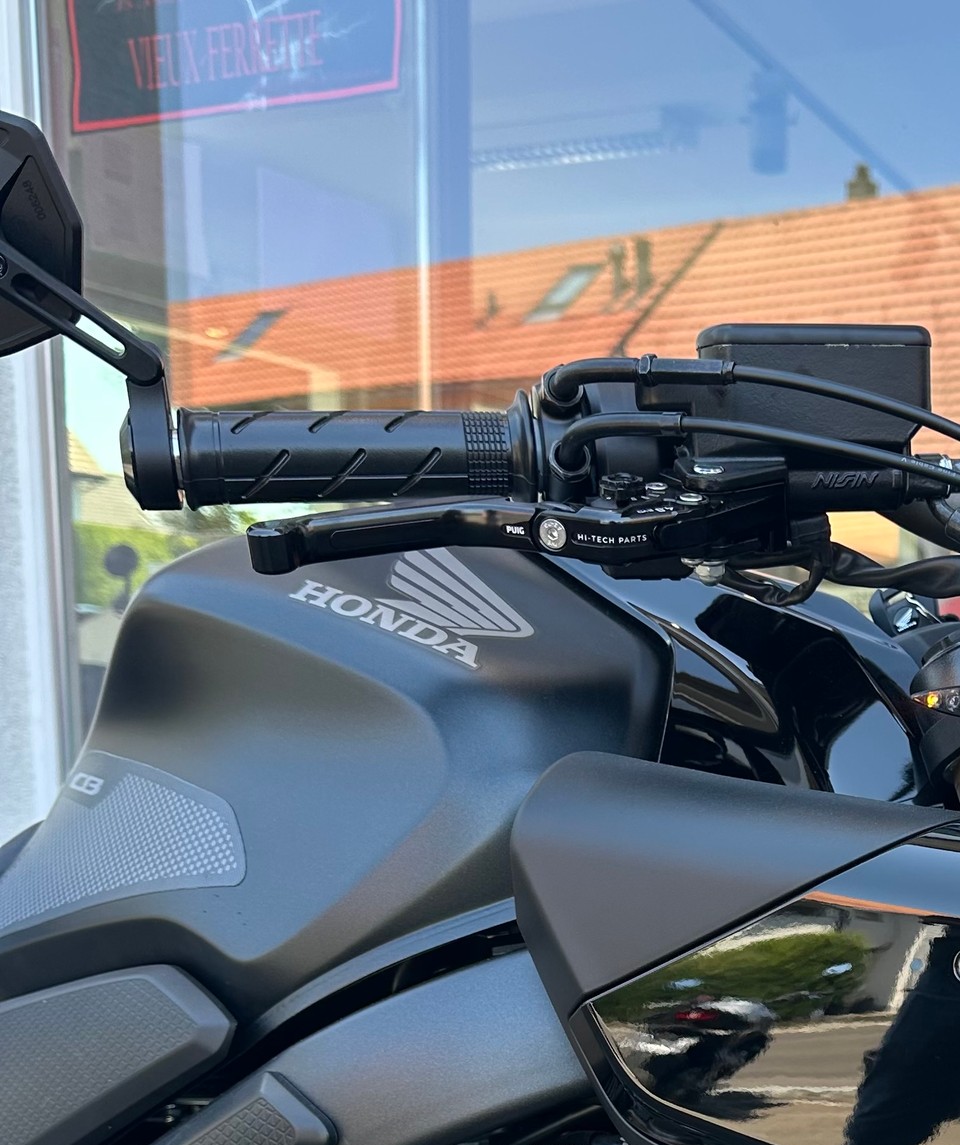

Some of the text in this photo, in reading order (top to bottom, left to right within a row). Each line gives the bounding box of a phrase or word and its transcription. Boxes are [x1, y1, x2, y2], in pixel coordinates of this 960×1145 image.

[506, 525, 525, 535] PUIG
[577, 533, 648, 544] HI-TECH PARTS
[288, 579, 478, 668] HONDA
[69, 771, 104, 796] CB
